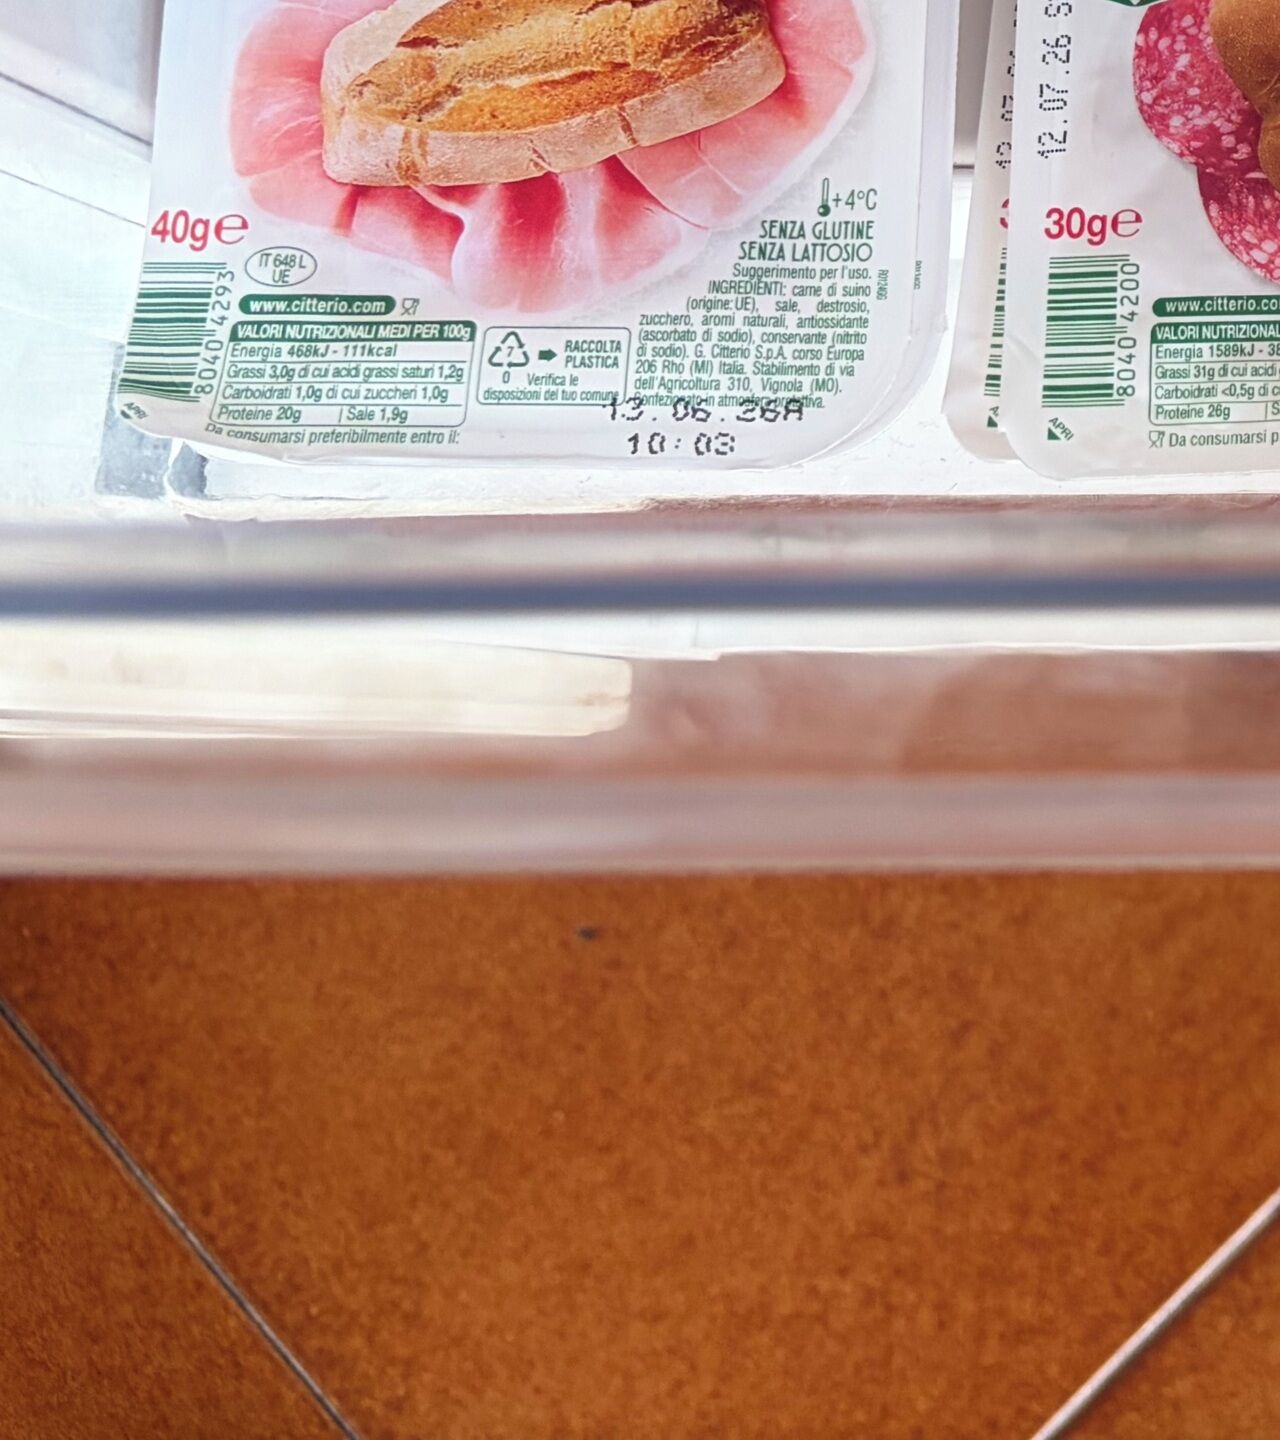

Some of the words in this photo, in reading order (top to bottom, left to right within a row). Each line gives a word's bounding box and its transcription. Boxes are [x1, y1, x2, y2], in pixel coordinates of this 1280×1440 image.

[831, 187, 878, 212] +4°C
[759, 220, 807, 240] SENZA
[811, 220, 875, 241] GLUTINE
[1043, 206, 1109, 247] 30g
[1110, 208, 1144, 239] e
[738, 241, 786, 262] SENZA
[791, 241, 874, 263] LATTOSIO
[1119, 262, 1142, 324] 4200
[249, 296, 387, 314] www.citterio.com
[193, 338, 225, 396] 8040
[210, 269, 235, 327] 4293
[236, 323, 283, 340] VALORI
[285, 323, 376, 340] NUTRIZIONALI
[377, 324, 414, 340] MEDI
[415, 324, 440, 340] PER
[442, 324, 472, 342] 100g
[1155, 324, 1200, 341] VALORI
[229, 343, 283, 361] Energia
[286, 344, 331, 359] 468kJ
[342, 342, 398, 359] 111kcal
[1154, 343, 1204, 362] Energia
[1207, 342, 1256, 360] 1589kJ
[1115, 336, 1138, 398] 8040
[1154, 403, 1205, 421] Proteine
[1206, 404, 1232, 422] 26g
[1048, 415, 1075, 441] APRI
[1168, 432, 1187, 448] Da
[1189, 429, 1268, 448] consumarsi
